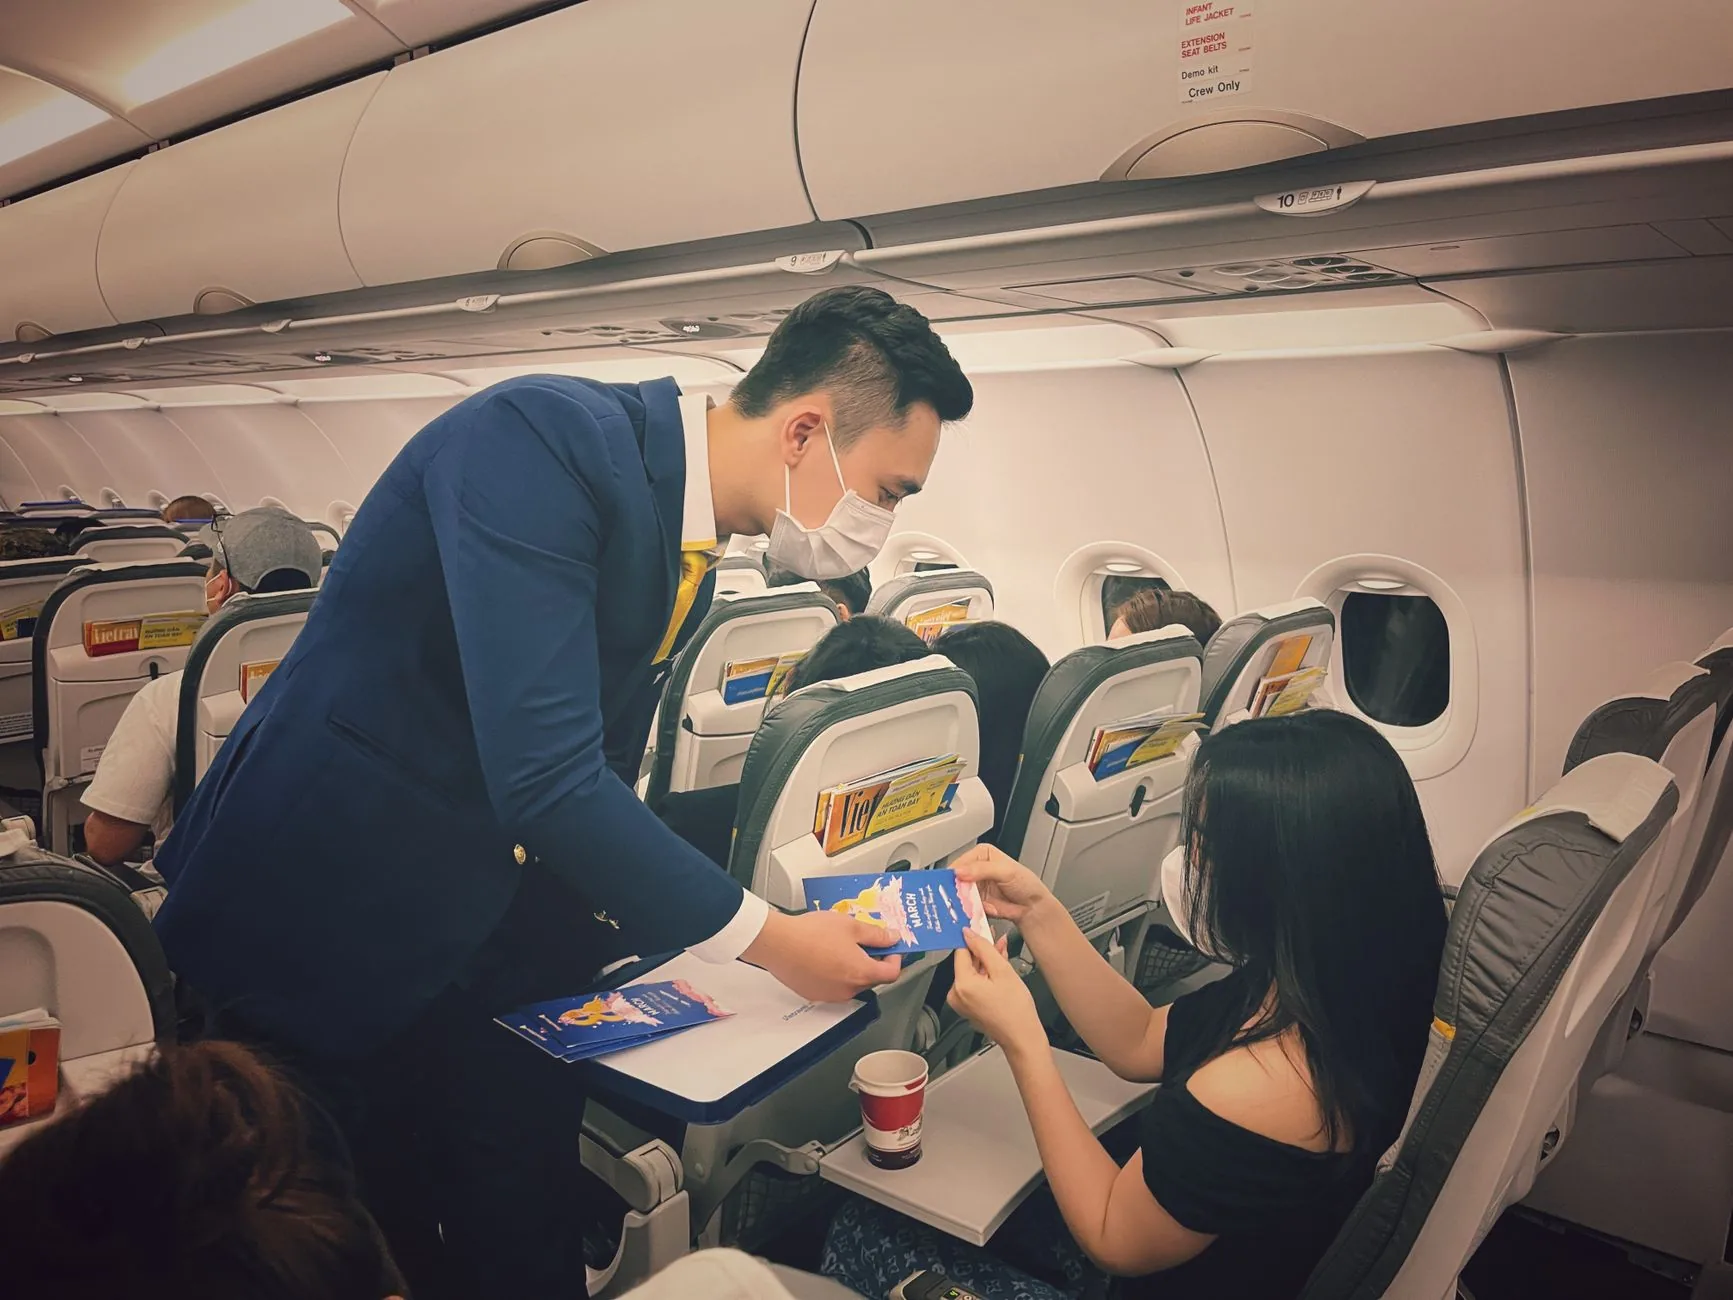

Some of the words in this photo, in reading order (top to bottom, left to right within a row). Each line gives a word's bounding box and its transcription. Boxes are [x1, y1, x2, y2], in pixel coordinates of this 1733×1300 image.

[1185, 2, 1213, 16] INFANT
[1185, 15, 1201, 26] LIFE
[1204, 7, 1234, 21] JACKET
[1181, 32, 1225, 49] EXTENSION
[1181, 47, 1200, 58] SEAT
[1203, 41, 1227, 54] BELTS
[1181, 68, 1205, 80] Demo
[1208, 65, 1219, 74] kit
[1188, 85, 1214, 98] Crew
[1217, 80, 1241, 92] Only
[1277, 193, 1295, 209] 10
[790, 255, 798, 267] 9
[906, 893, 923, 927] MARCH
